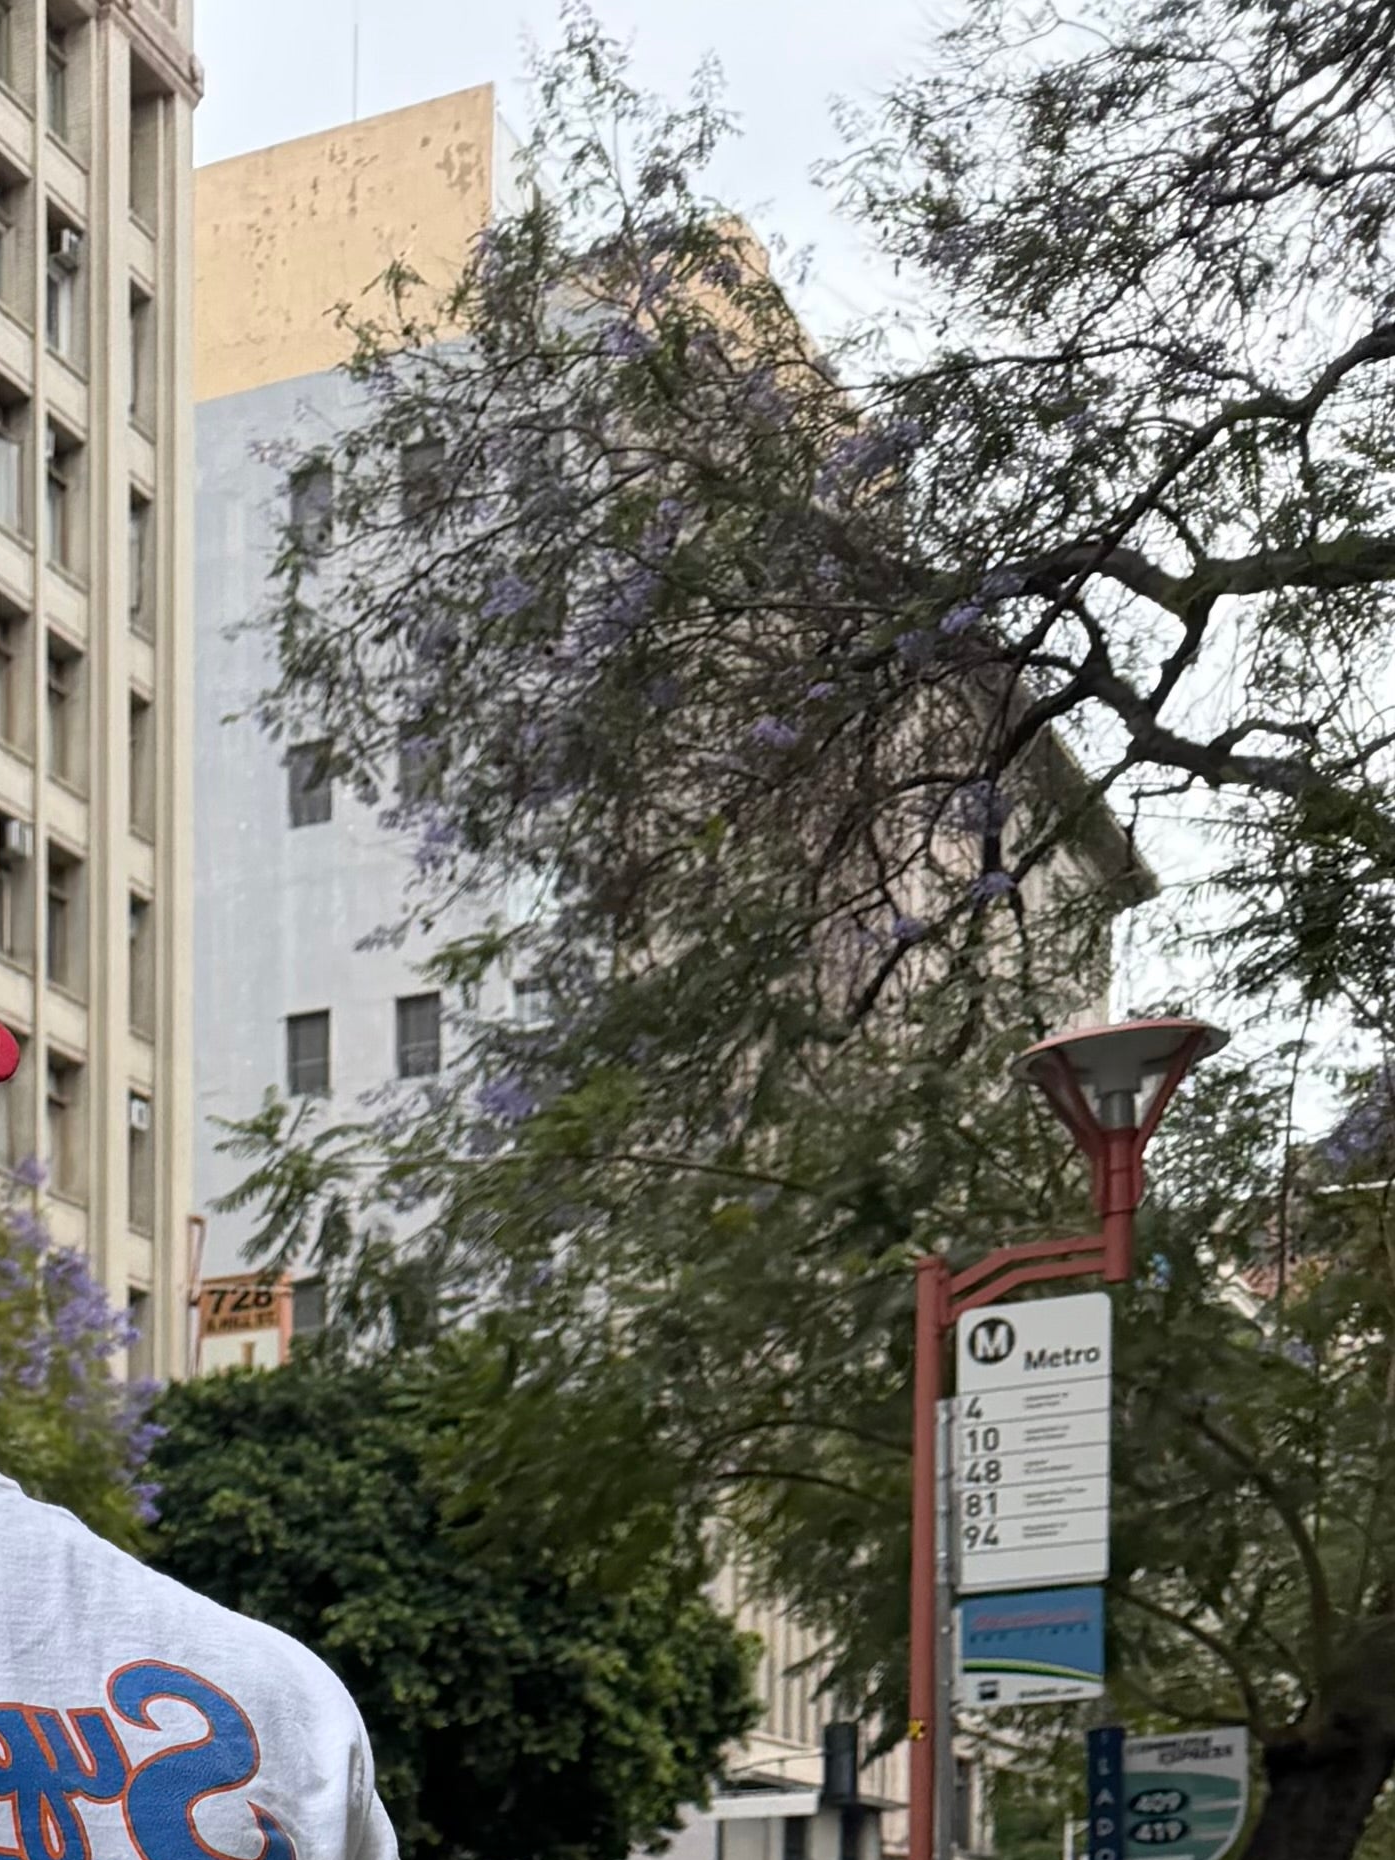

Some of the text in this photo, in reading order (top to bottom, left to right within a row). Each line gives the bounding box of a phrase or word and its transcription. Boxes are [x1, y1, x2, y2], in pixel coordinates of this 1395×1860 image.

[974, 1324, 1009, 1360] M
[1023, 1346, 1101, 1371] Metro
[966, 1397, 983, 1419] 4
[967, 1427, 1000, 1453] 10
[966, 1460, 1002, 1484] 48
[966, 1492, 997, 1517] 81
[965, 1523, 999, 1549] 94
